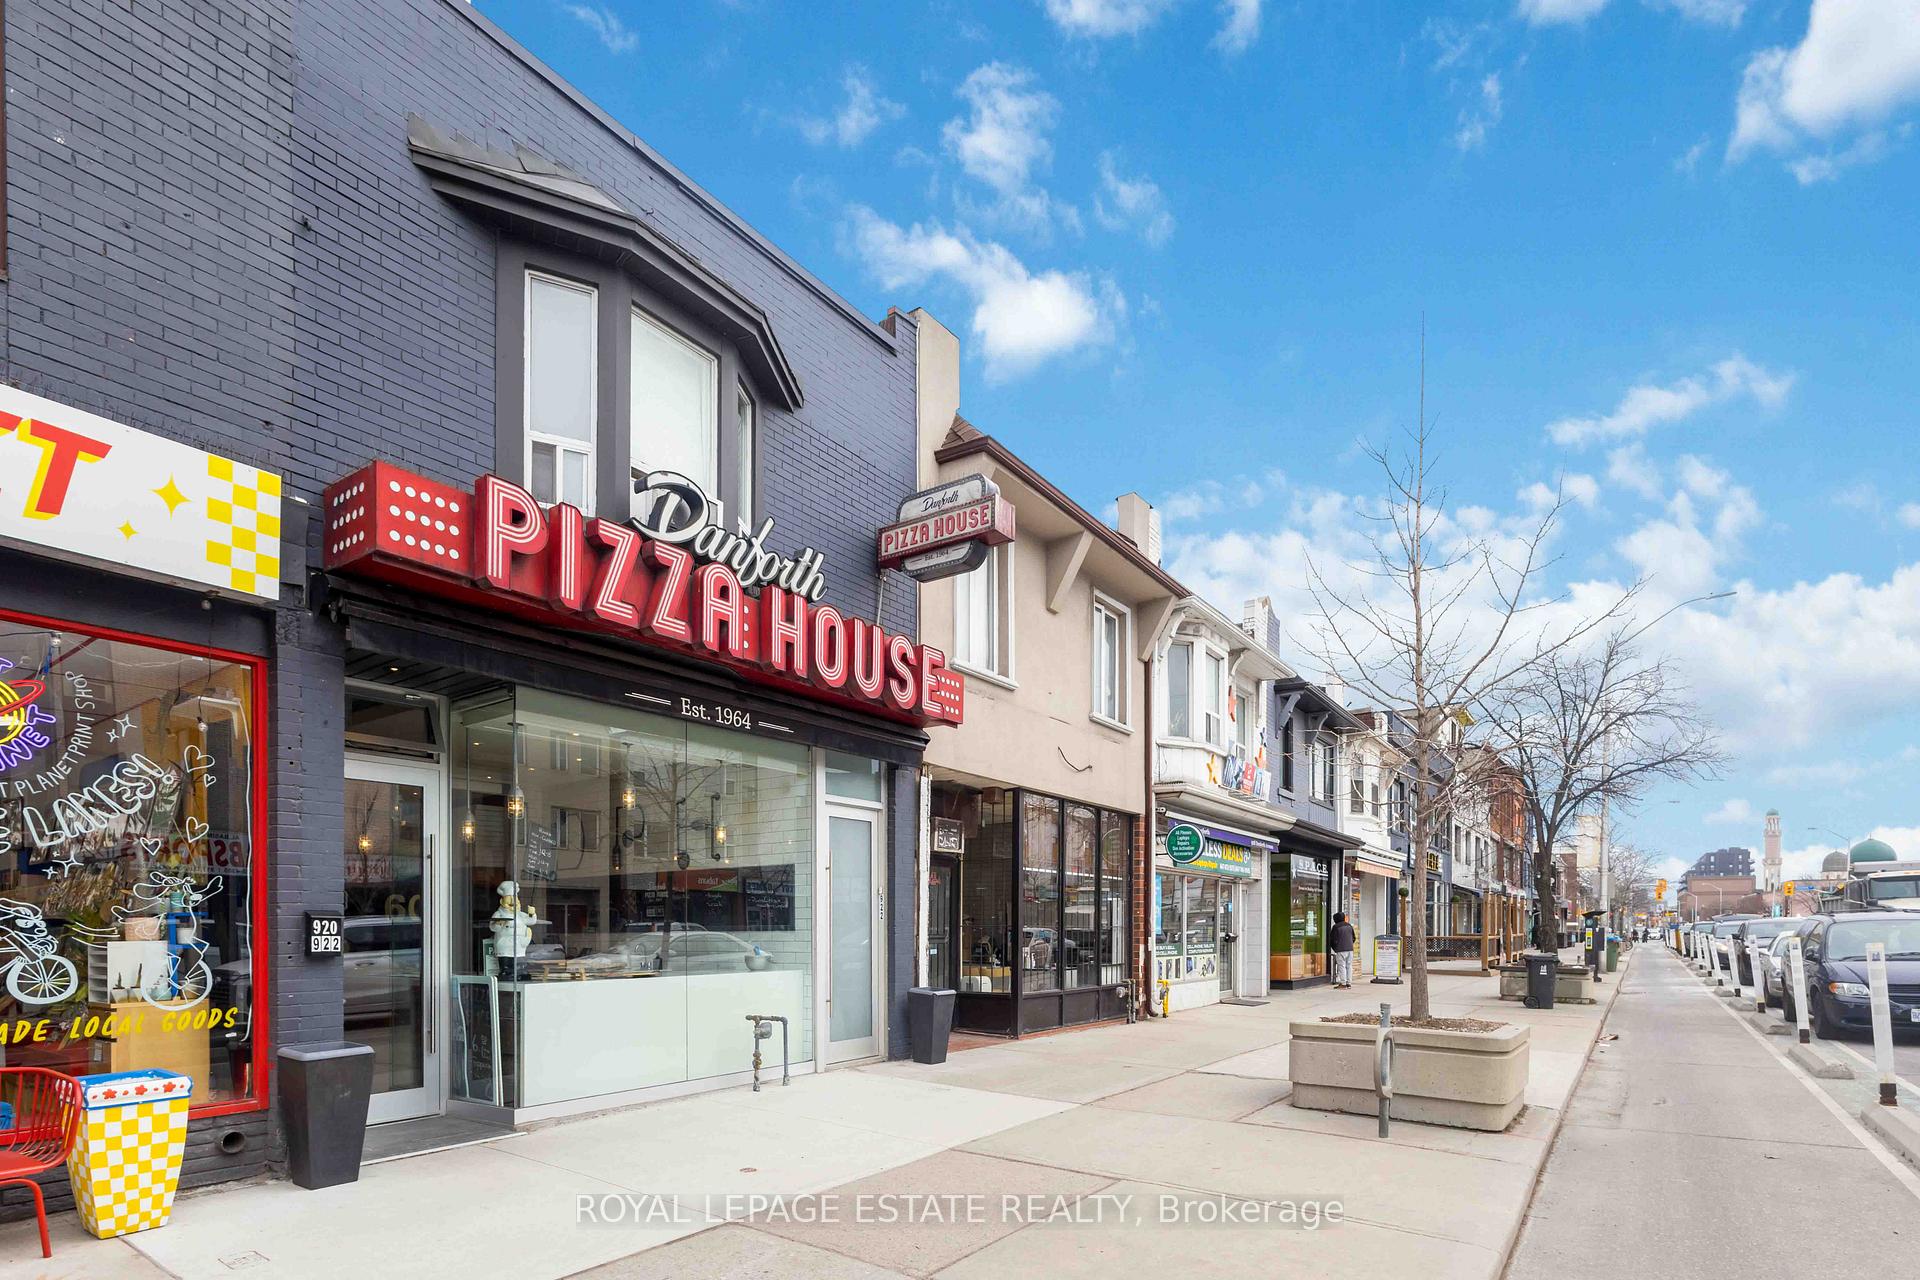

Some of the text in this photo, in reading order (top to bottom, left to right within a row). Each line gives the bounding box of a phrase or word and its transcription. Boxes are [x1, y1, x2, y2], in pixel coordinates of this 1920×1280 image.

[0, 408, 112, 522] T
[921, 490, 959, 512] Danforth
[630, 470, 828, 602] Danforth
[884, 504, 989, 553] PIZZA HOUSE
[476, 473, 946, 722] PIZZA HOUSE
[65, 671, 96, 710] SHOP
[680, 697, 751, 729] Est. 1964
[0, 704, 57, 772] NET
[68, 713, 96, 757] PRINT
[15, 752, 79, 797] PLANET
[1202, 840, 1222, 859] LESS
[1223, 844, 1243, 863] DEALS
[312, 919, 338, 935] 920
[313, 937, 340, 951] 922
[70, 1011, 145, 1039] LOCAL
[162, 1007, 239, 1033] GOODS
